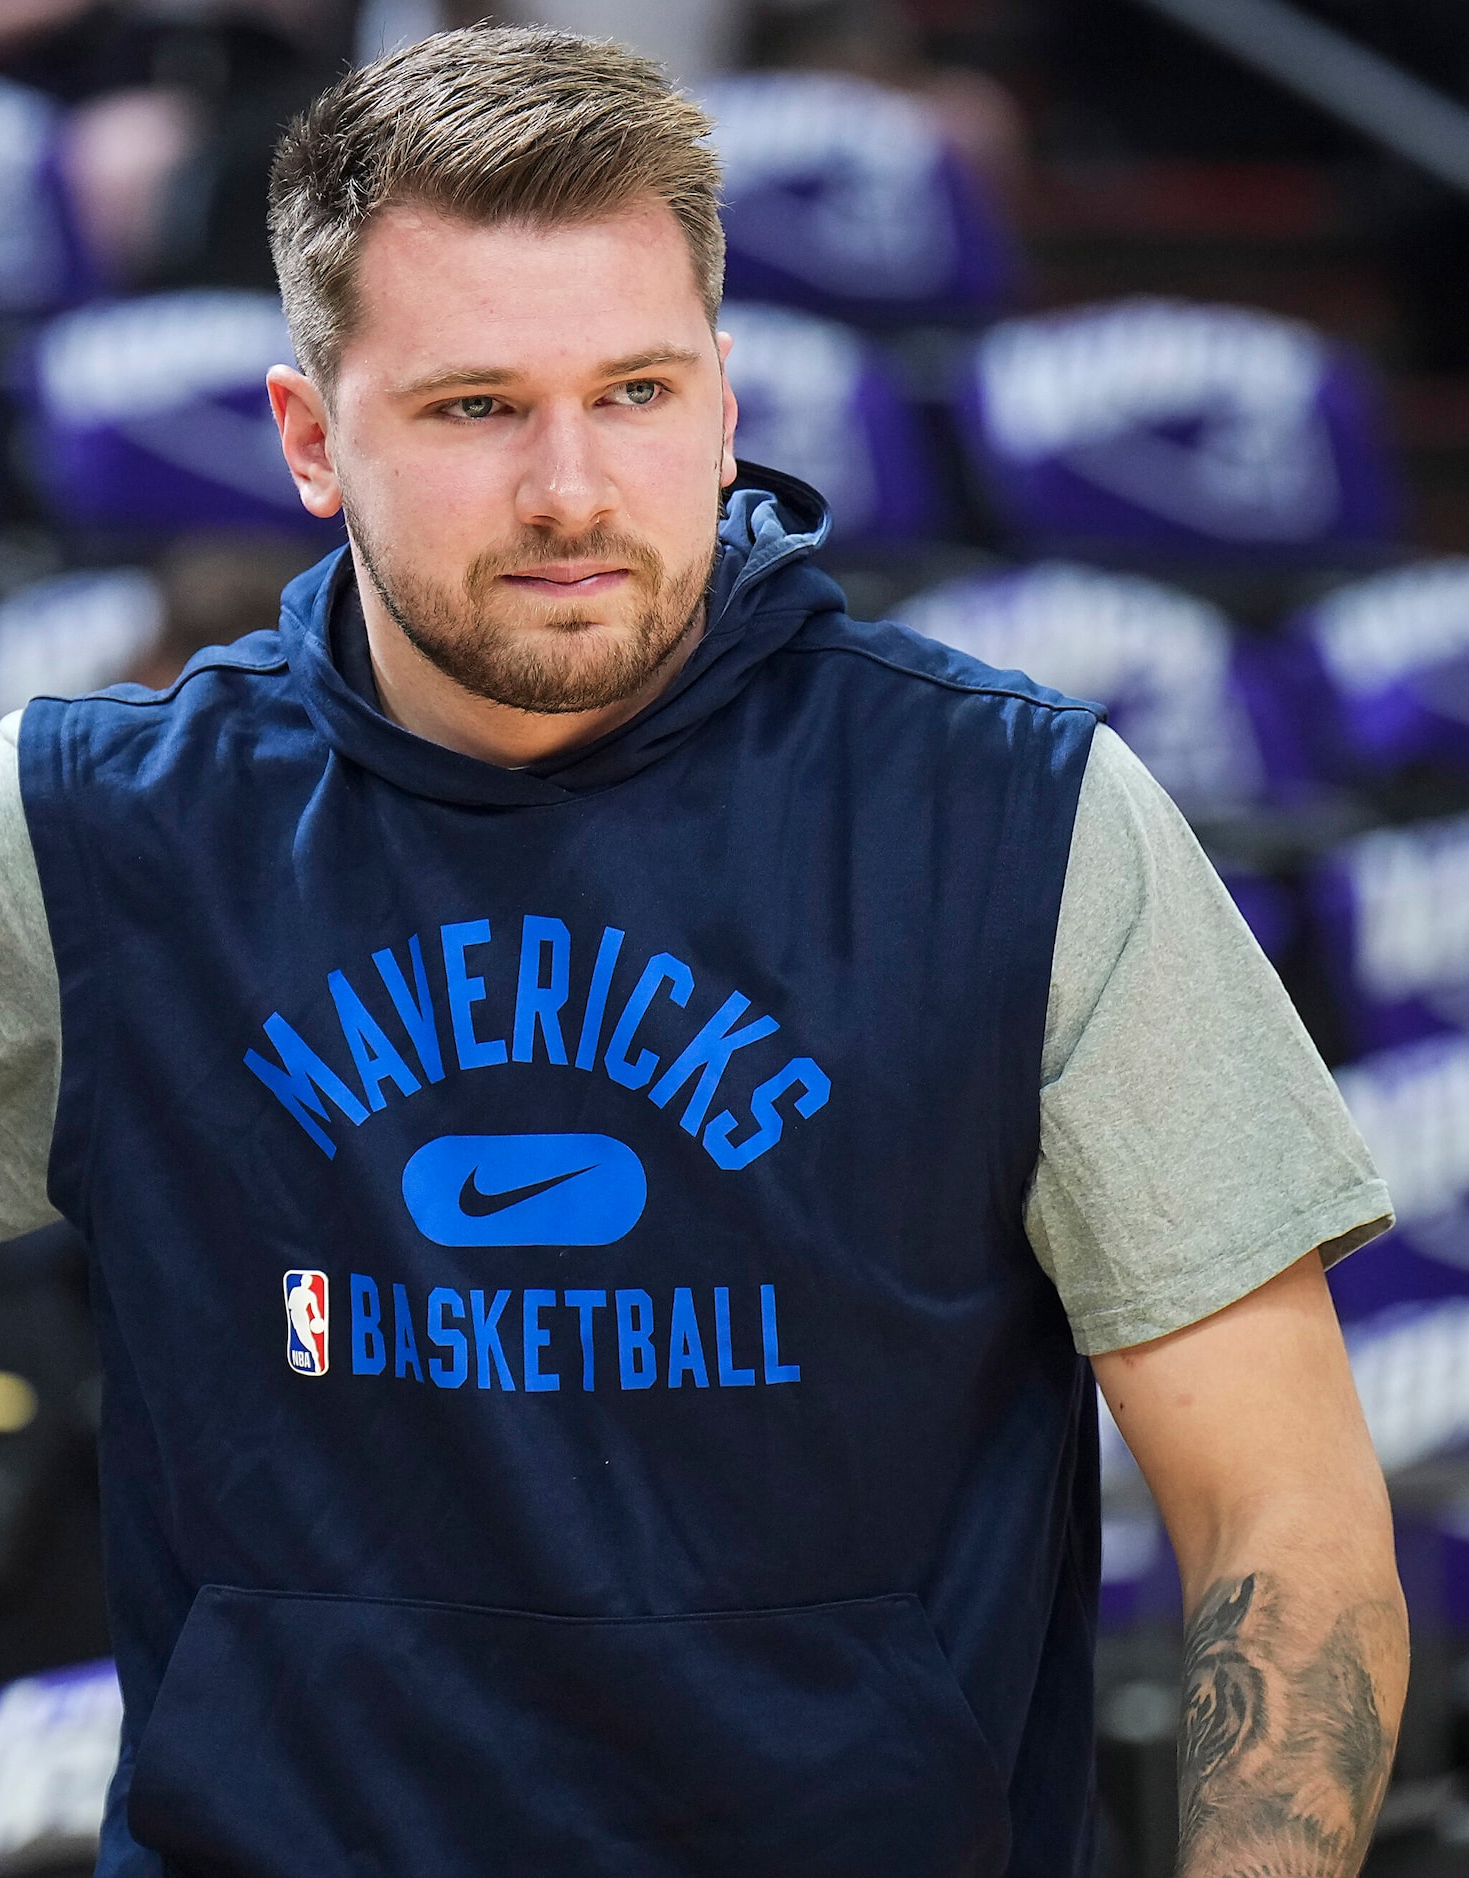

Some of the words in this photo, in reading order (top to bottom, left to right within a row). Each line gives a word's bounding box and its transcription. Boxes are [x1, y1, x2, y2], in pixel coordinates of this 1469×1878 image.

[243, 914, 832, 1171] MAVERICKS
[292, 1351, 311, 1368] NBA
[350, 1272, 801, 1392] BASKETBALL
